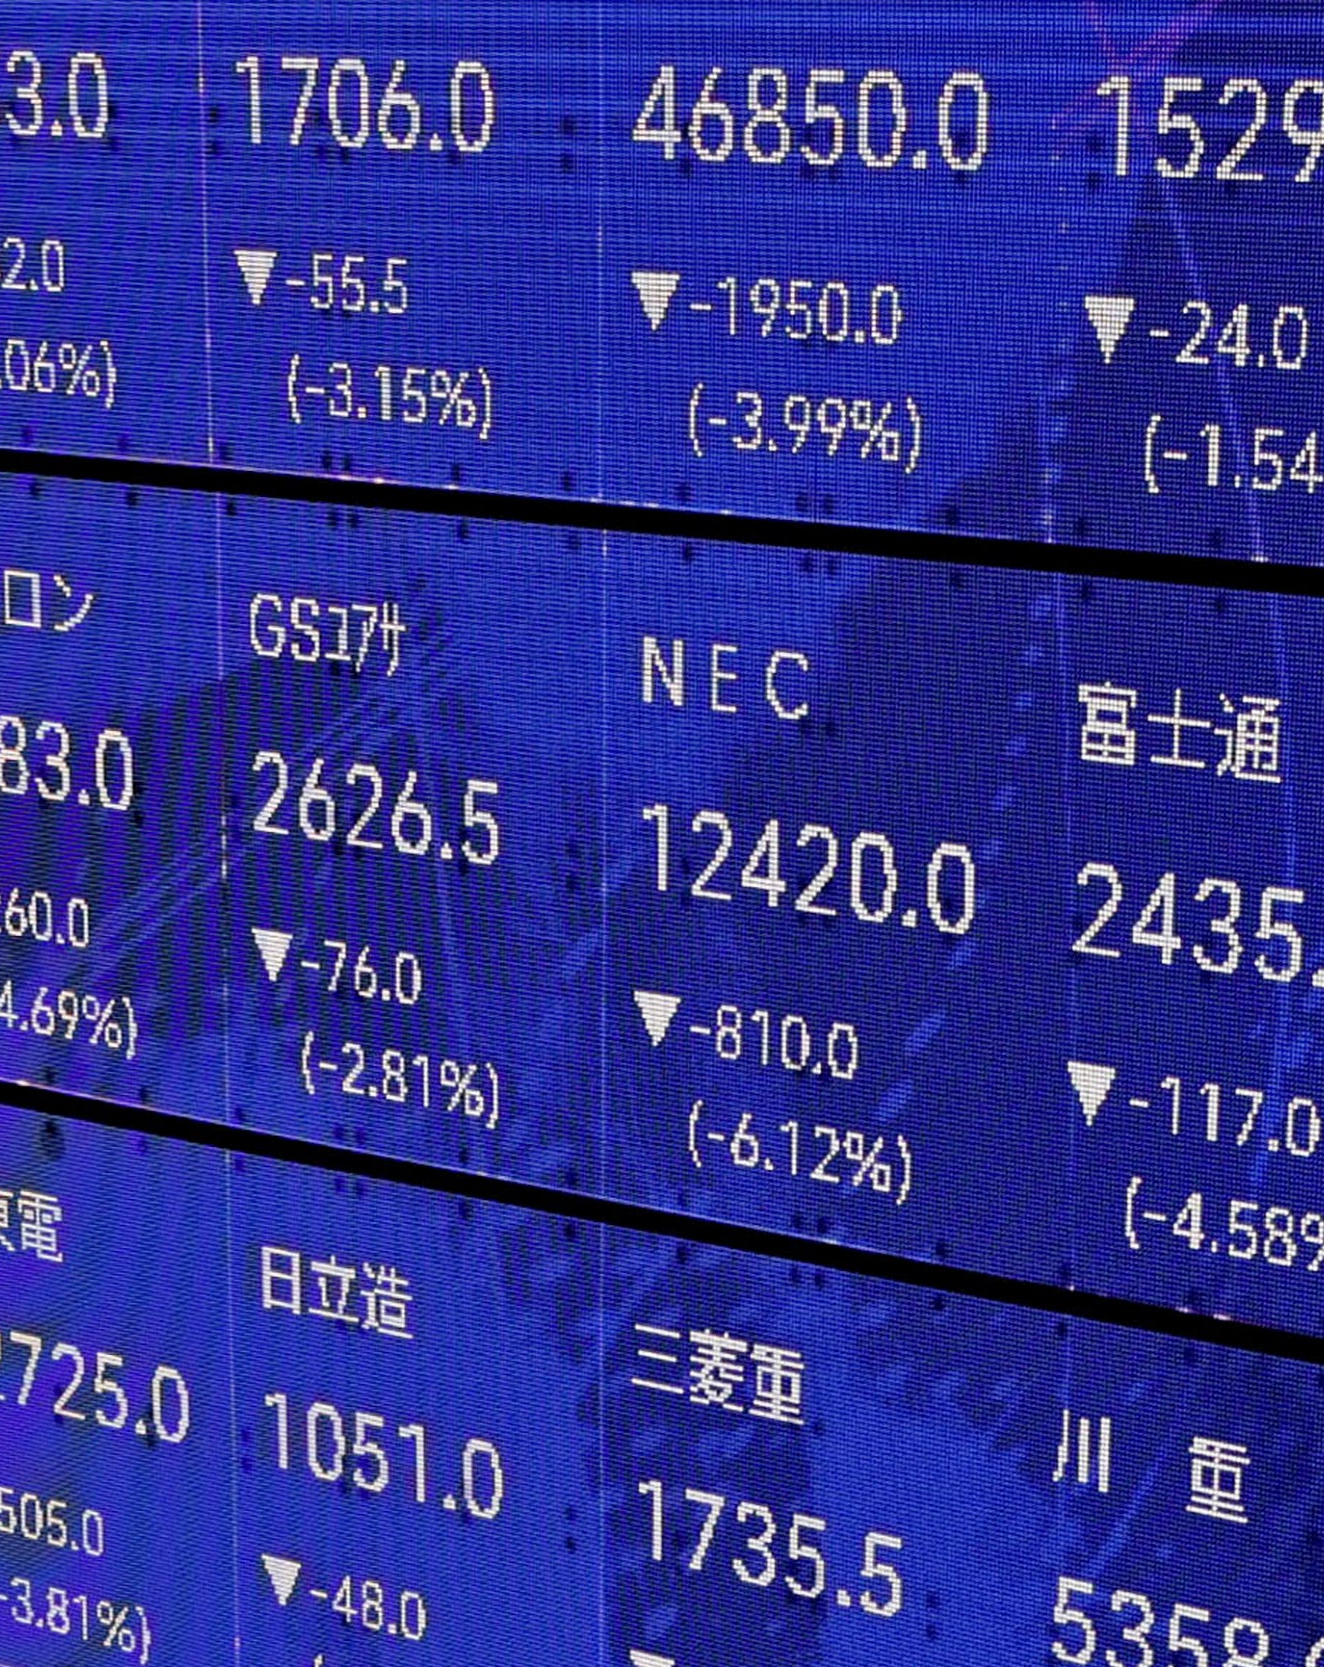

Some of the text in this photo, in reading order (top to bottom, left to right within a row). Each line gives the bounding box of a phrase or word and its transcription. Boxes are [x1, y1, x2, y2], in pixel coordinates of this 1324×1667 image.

[235, 55, 494, 154] 1706.0
[632, 64, 989, 172] 46850.0
[1149, 299, 1309, 371] -24.0
[287, 354, 492, 441] (-3.15%)
[1077, 680, 1282, 785] 富士通
[252, 750, 500, 866] 2626.5
[300, 939, 423, 1006] -76.0
[261, 1245, 413, 1340] 日立造
[631, 1323, 805, 1425] 三菱重
[264, 1392, 504, 1520] 1051.0
[638, 1479, 903, 1618] 1735.5
